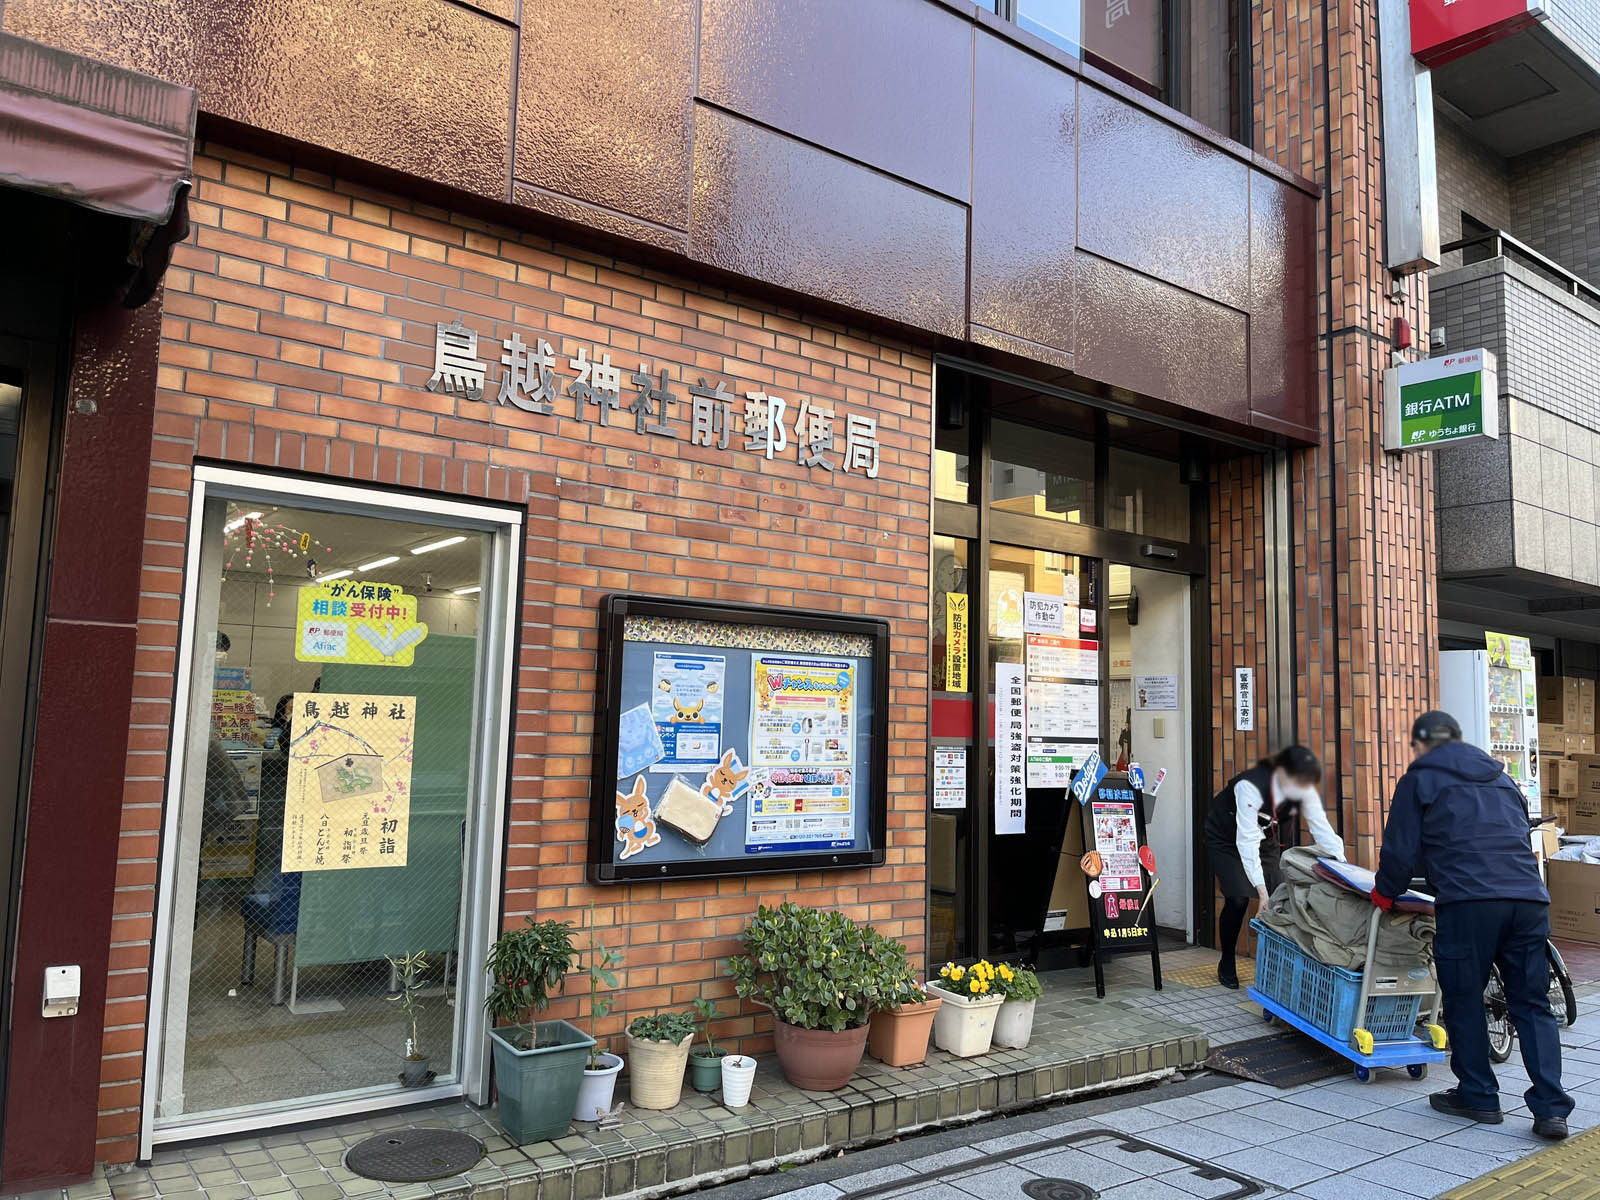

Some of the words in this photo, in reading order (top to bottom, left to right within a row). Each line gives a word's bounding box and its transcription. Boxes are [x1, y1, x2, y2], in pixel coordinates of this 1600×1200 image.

[425, 320, 879, 478] 鳥越神社前郵便局
[1405, 393, 1470, 417] 銀行ATM
[1429, 423, 1476, 438] ゆうちょ銀行
[1030, 600, 1059, 612] 防犯カメラ
[1035, 611, 1055, 621] 作動中
[952, 613, 962, 688] 防犯カメラ設置地域
[303, 700, 406, 720] 鳥越神社
[1240, 673, 1249, 725] 警察官立寄所
[1010, 676, 1022, 818] 全国郵便局強盗対策強化期間
[379, 817, 398, 854] 初詣
